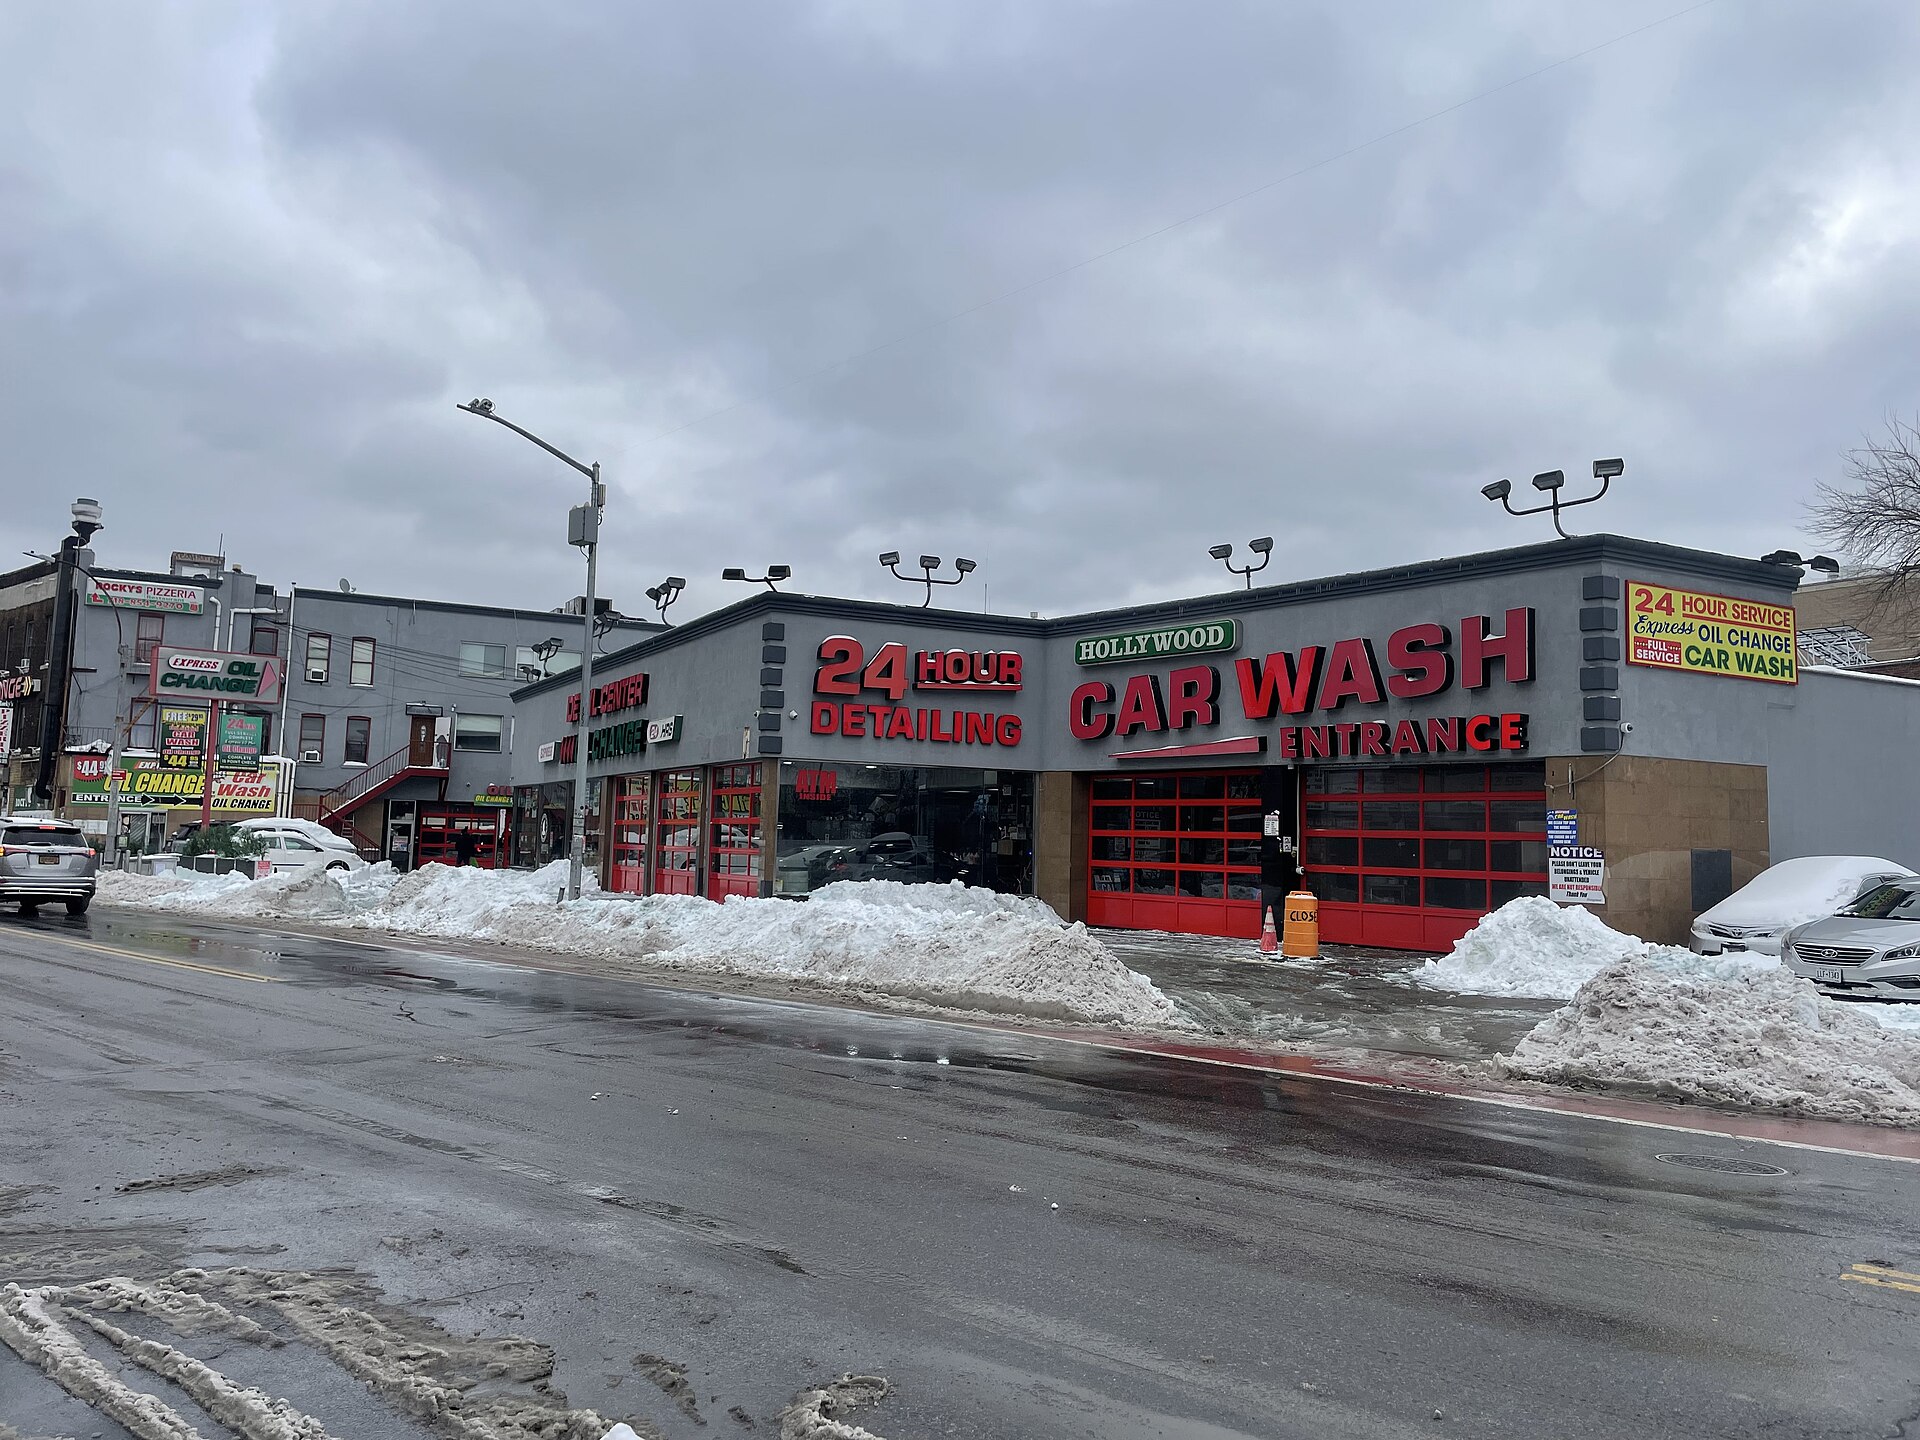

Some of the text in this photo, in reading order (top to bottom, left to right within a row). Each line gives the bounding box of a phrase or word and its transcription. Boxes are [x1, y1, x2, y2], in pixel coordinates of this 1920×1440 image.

[146, 586, 197, 599] PIZZERIA
[1635, 588, 1791, 628] 24 HOUR SERVICE
[1079, 625, 1225, 661] HOLLYWOOD
[1634, 614, 1791, 653] Express OIL CHANGE
[1648, 639, 1667, 651] FULL
[1636, 649, 1680, 663] SERVICE
[1685, 645, 1794, 678] CAR WASH
[172, 657, 260, 677] EXPRESS OIL
[813, 635, 1023, 700] 24 HOUR
[1069, 606, 1535, 740] CAR WASH
[160, 672, 258, 694] CHANGE
[600, 673, 646, 714] CENTER
[166, 711, 189, 721] FREE
[226, 718, 244, 729] 24
[810, 701, 1023, 747] DETAILING
[166, 738, 200, 746] WASH
[592, 719, 645, 761] CHANGE
[1279, 713, 1529, 758] ENTRANCE
[135, 773, 205, 794] CHANGE
[217, 784, 271, 798] Wash
[795, 769, 837, 794] ATM
[75, 793, 142, 803] ENTRNCE
[212, 798, 272, 810] OIL CHANGE
[486, 795, 510, 803] CHANGE
[799, 793, 832, 801] INSIDE
[1550, 846, 1603, 858] NOTICE
